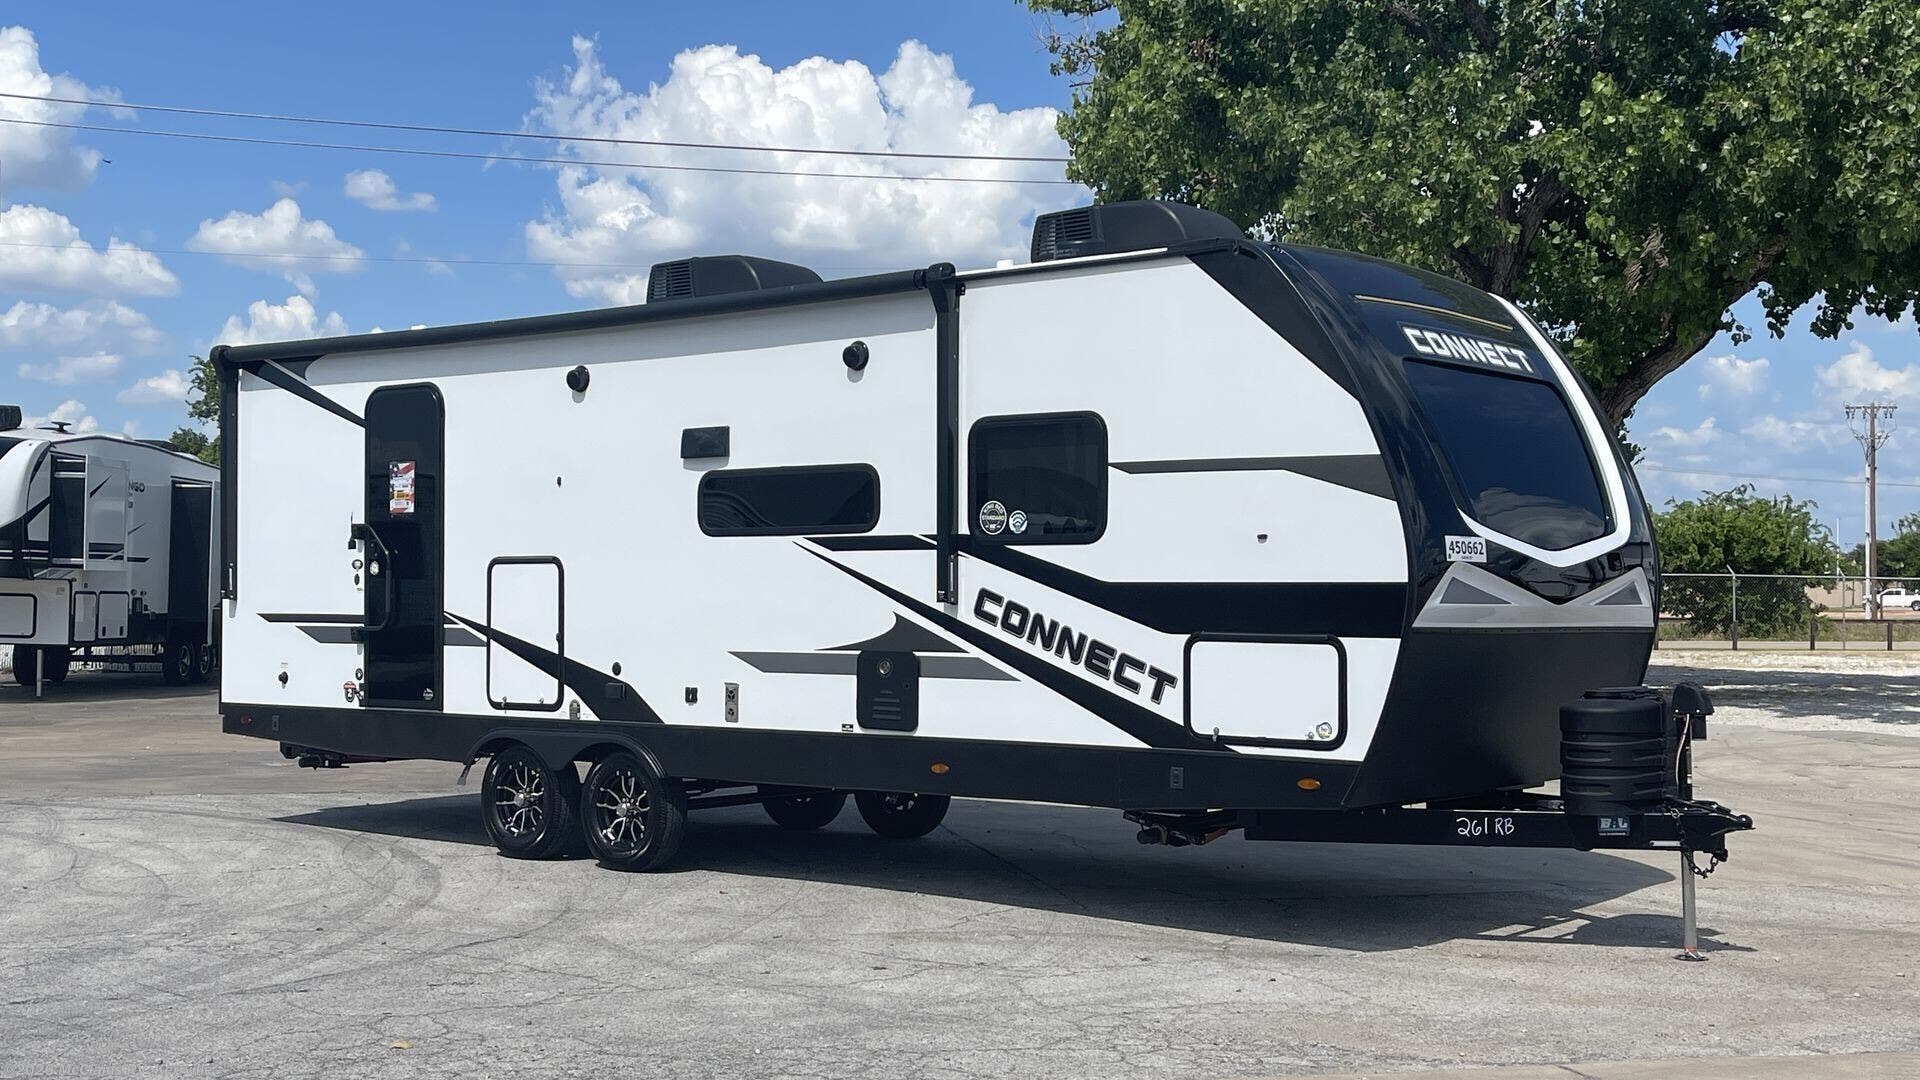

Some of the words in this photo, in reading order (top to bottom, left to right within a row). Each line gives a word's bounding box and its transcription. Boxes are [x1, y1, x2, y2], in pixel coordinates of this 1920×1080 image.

[1402, 326, 1534, 373] CONNECT
[1448, 540, 1484, 555] 450662
[973, 587, 1179, 706] CONNECT
[1455, 816, 1488, 837] 261
[1494, 816, 1515, 836] RB
